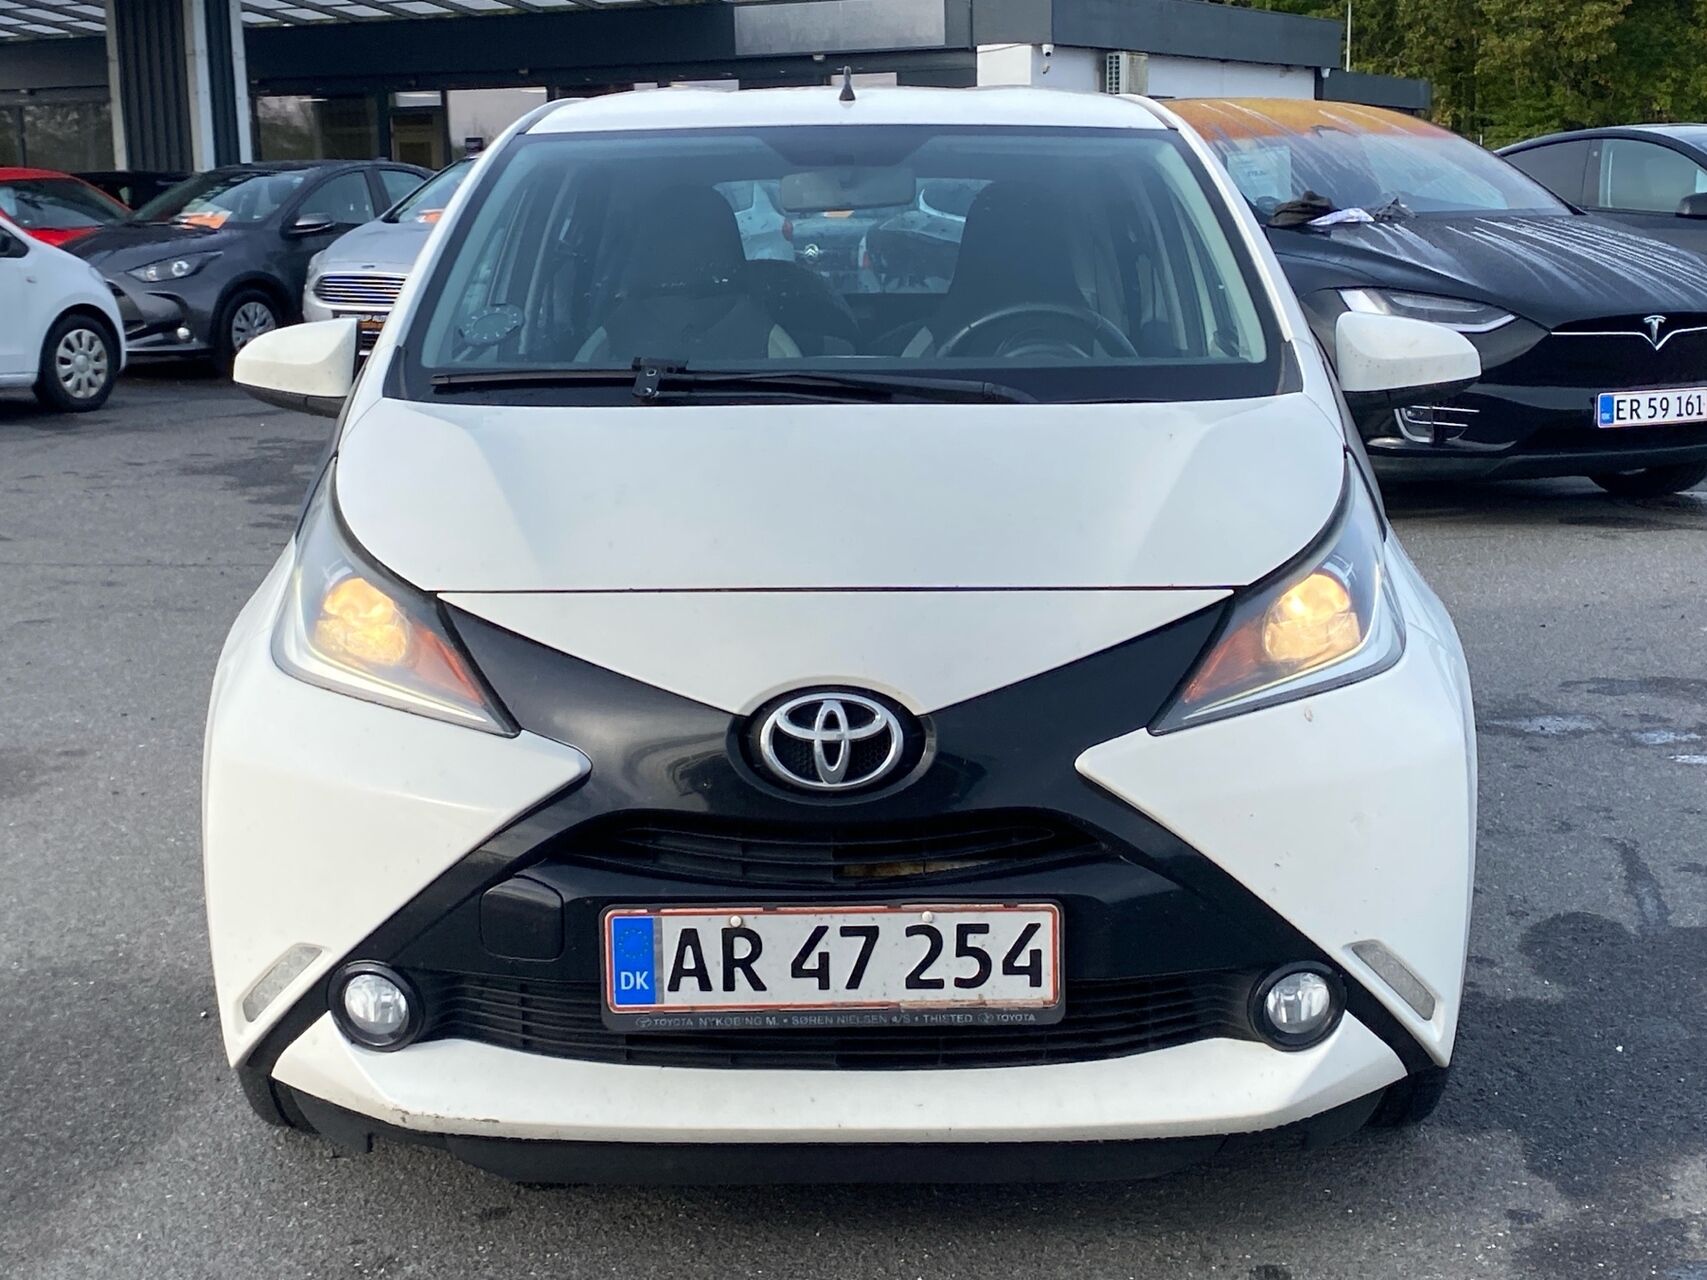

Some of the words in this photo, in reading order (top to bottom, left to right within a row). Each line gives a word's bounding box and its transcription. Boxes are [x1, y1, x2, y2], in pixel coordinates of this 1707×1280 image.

[1616, 399, 1641, 420] ER
[1648, 397, 1669, 418] 59
[1676, 394, 1703, 417] 161
[667, 927, 767, 992] AR
[791, 925, 880, 990] 47
[905, 923, 1042, 989] 254
[620, 971, 649, 990] DK
[653, 1018, 693, 1026] TOYOTA
[923, 1014, 973, 1023] THISTED
[996, 1013, 1036, 1022] TOYOTA
